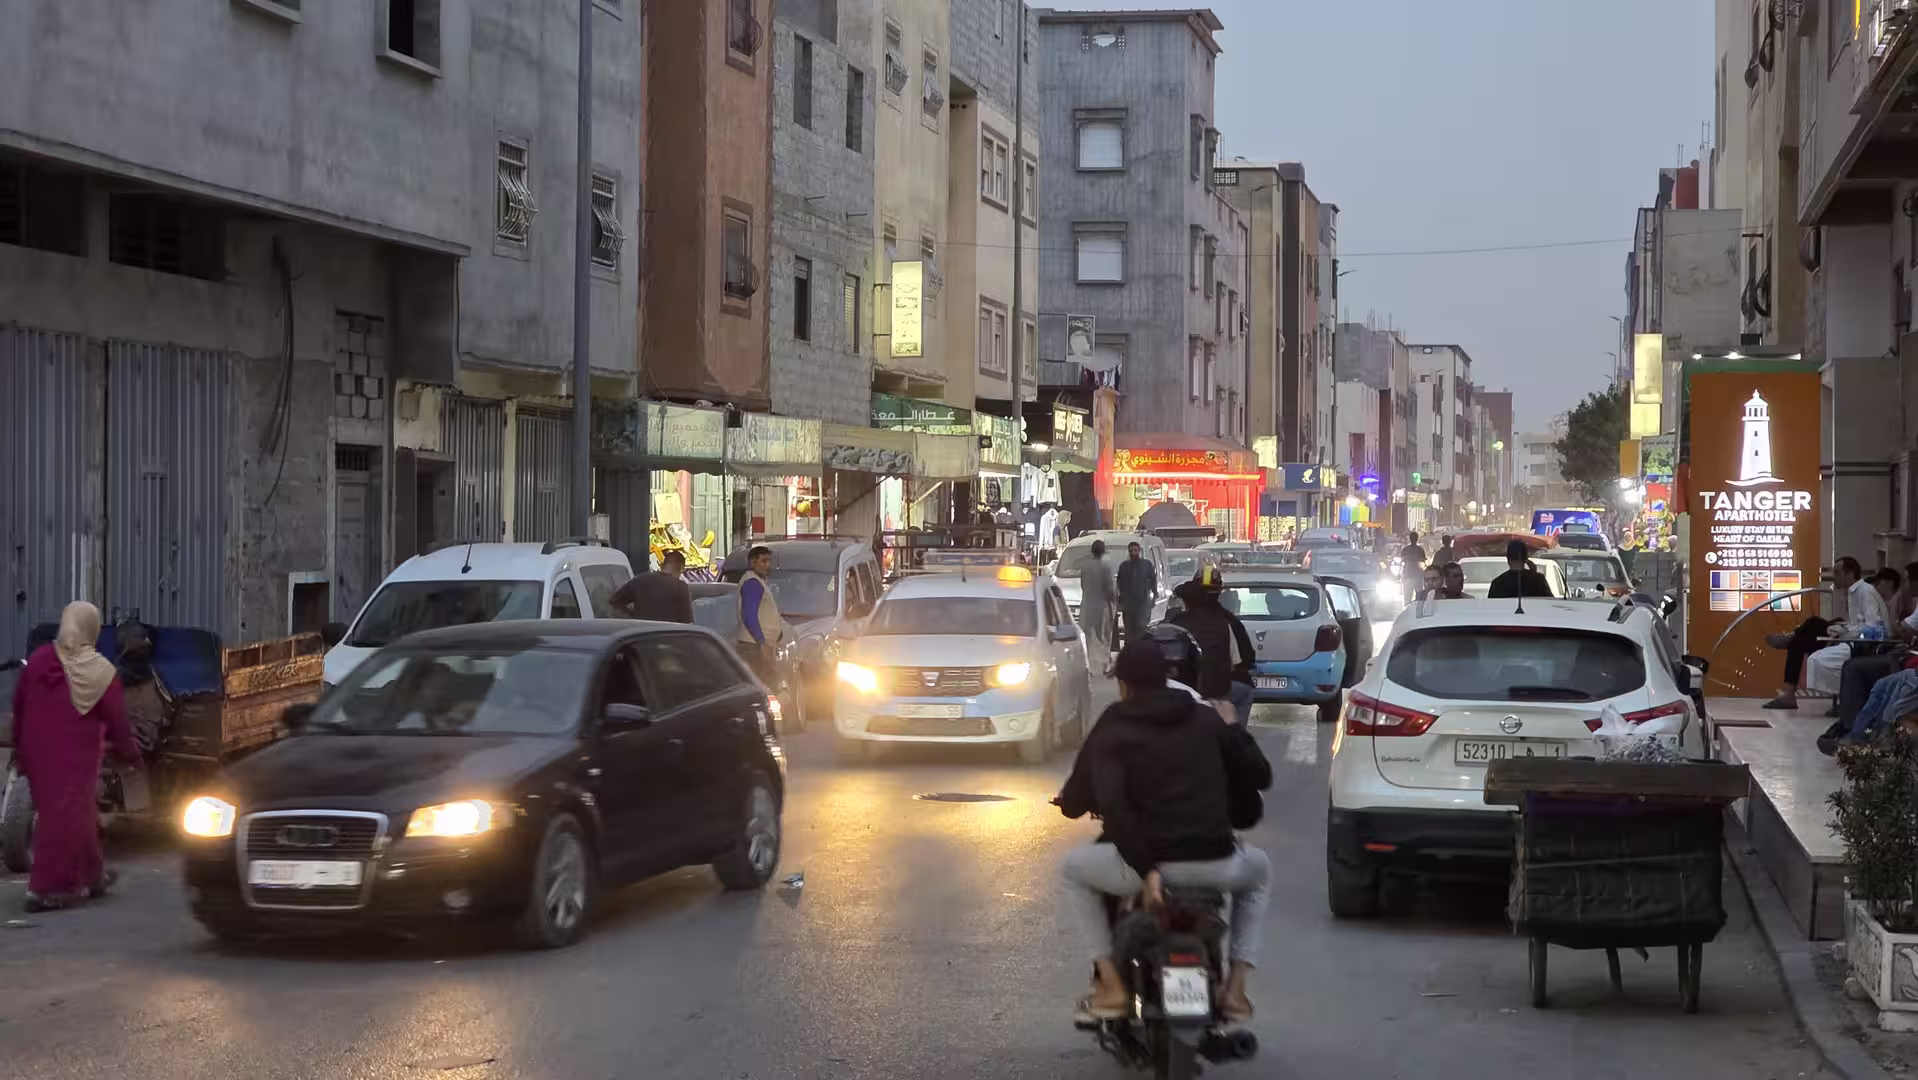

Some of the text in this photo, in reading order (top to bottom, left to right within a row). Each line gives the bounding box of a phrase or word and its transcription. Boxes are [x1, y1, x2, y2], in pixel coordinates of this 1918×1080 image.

[1175, 453, 1205, 466] مجزرة
[1699, 490, 1812, 510] TANGER
[1714, 510, 1796, 522] APARTHOTEL
[1711, 525, 1744, 534] LUXURY
[1744, 525, 1765, 534] STAY
[1776, 525, 1794, 534] THE
[1713, 535, 1791, 543] HEART OF DAKHLA
[1717, 549, 1737, 557] +212
[1718, 558, 1738, 567] +212
[1463, 743, 1506, 759] 52310
